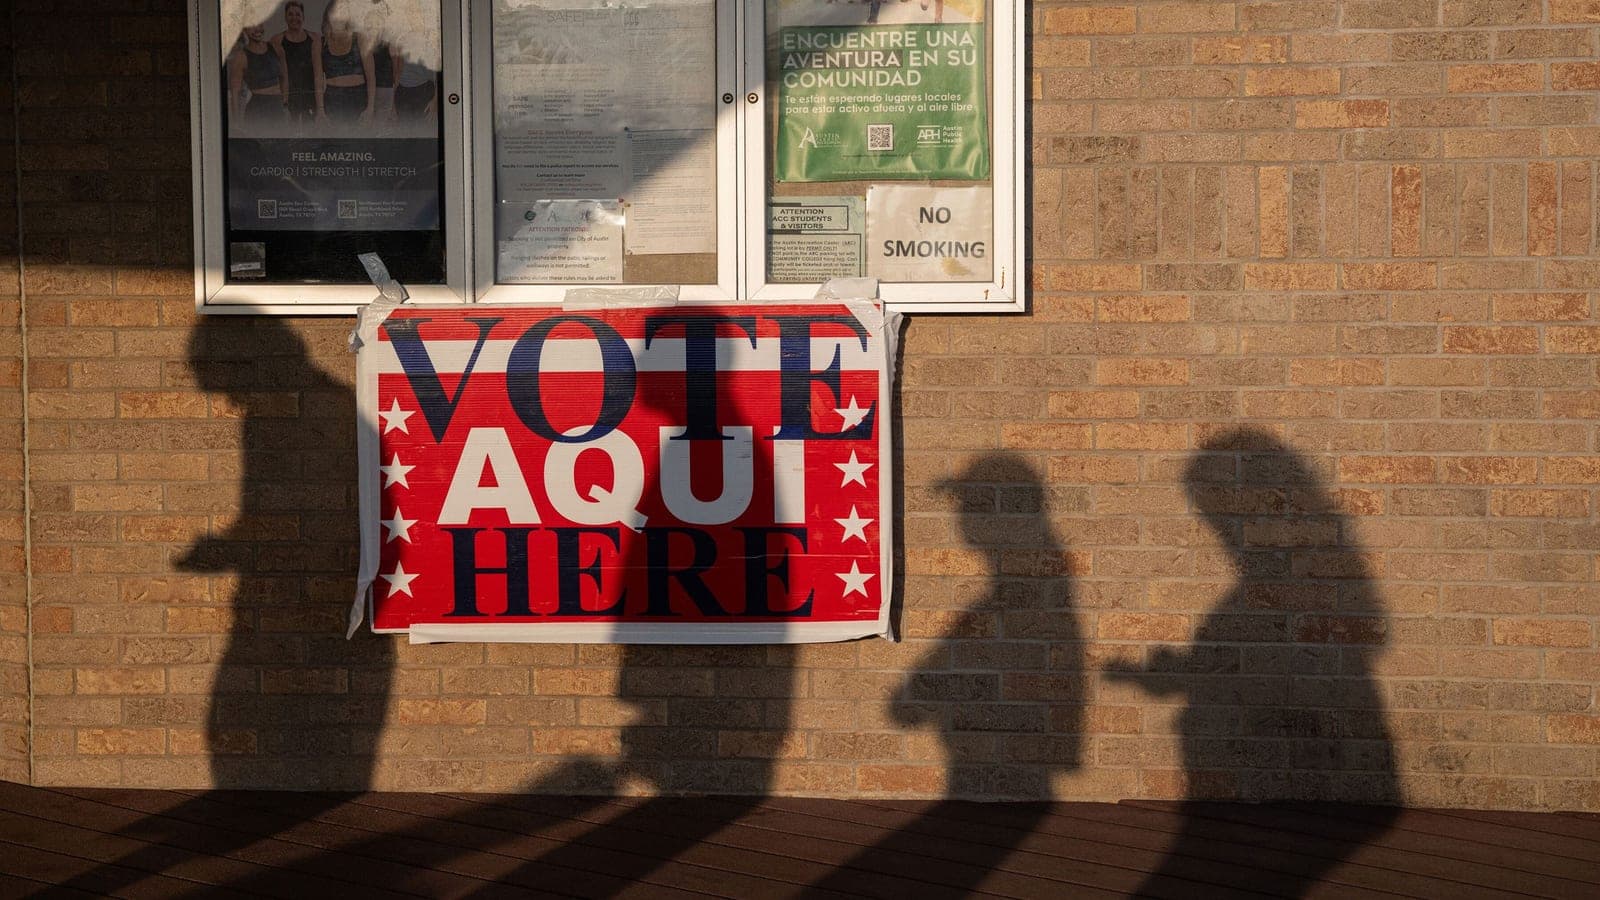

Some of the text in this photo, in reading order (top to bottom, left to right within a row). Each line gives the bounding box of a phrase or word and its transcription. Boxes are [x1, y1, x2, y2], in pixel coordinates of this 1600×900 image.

[783, 31, 974, 50] ENCUENTRE UNA
[783, 49, 976, 68] AVENTURA EN SU
[784, 70, 921, 88] COMUNIDAD
[785, 93, 961, 105] Te están esperando lugares locales
[786, 102, 973, 114] para estar activo afuera y al aire libre
[917, 129, 940, 140] APH
[292, 152, 375, 162] FEEL AMAZING.
[250, 167, 293, 177] CARDIO
[302, 166, 359, 176] STRENGTH
[368, 166, 416, 176] STRETCH
[919, 206, 951, 224] NO
[883, 240, 985, 258] SMOKING
[380, 313, 876, 443] VOTE
[437, 425, 806, 533] AQUI
[442, 527, 815, 617] HERE
